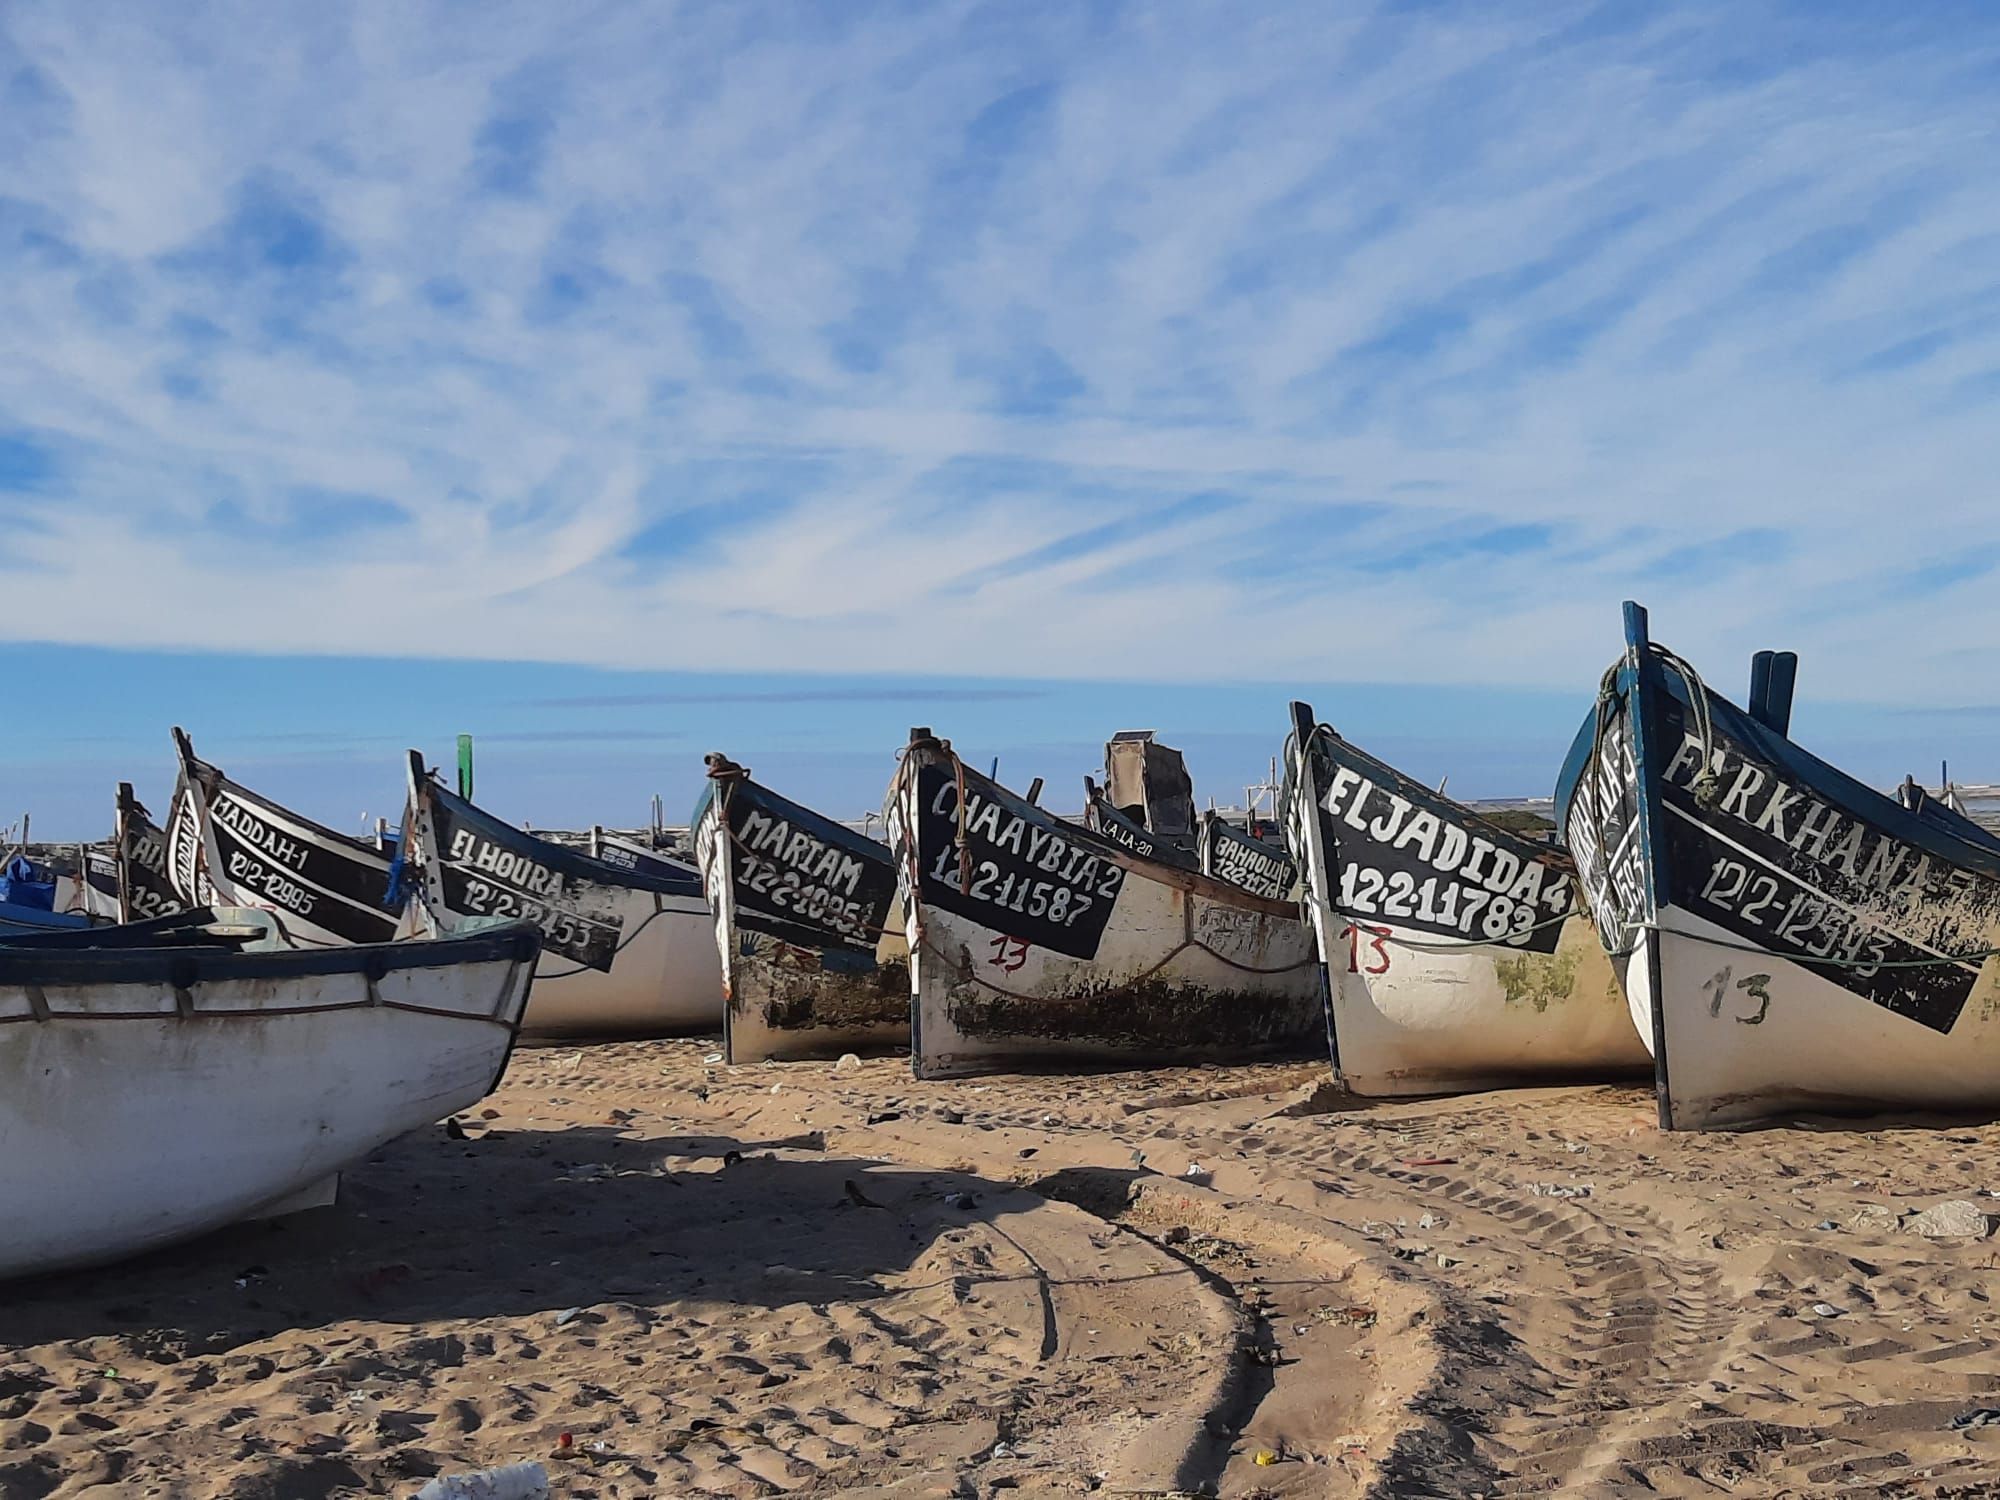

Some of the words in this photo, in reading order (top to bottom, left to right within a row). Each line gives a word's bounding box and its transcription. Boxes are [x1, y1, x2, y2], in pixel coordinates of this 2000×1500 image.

[211, 794, 309, 871] MADDAH-1
[738, 810, 864, 897] MARIAM
[988, 935, 1032, 972] 13
[1339, 923, 1391, 974] 13
[1702, 964, 1771, 1026] 13
